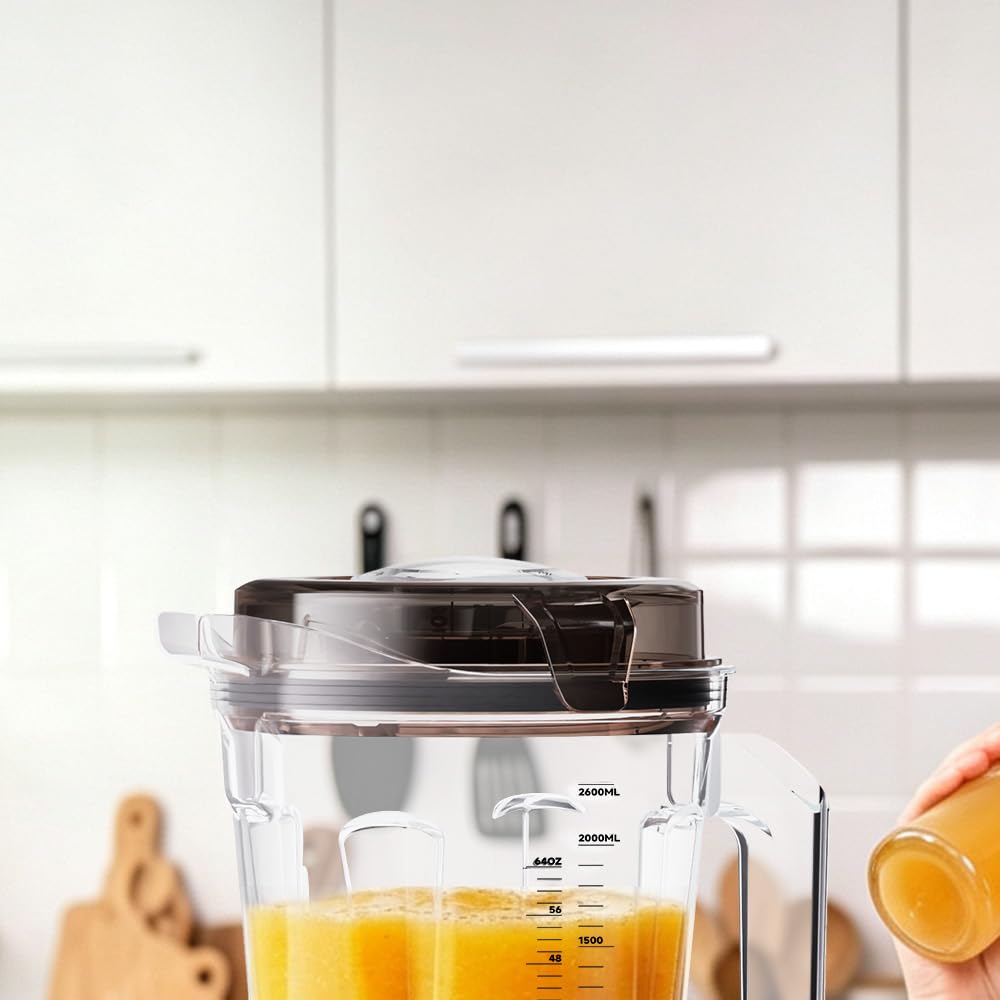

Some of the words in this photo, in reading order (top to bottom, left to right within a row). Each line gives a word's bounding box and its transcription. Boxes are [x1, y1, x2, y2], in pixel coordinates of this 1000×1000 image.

[578, 787, 620, 796] 2600ML
[578, 833, 620, 842] 2000ML
[534, 856, 562, 866] 64OZ
[549, 905, 562, 914] 56
[578, 936, 604, 945] 1500
[549, 953, 562, 962] 48
